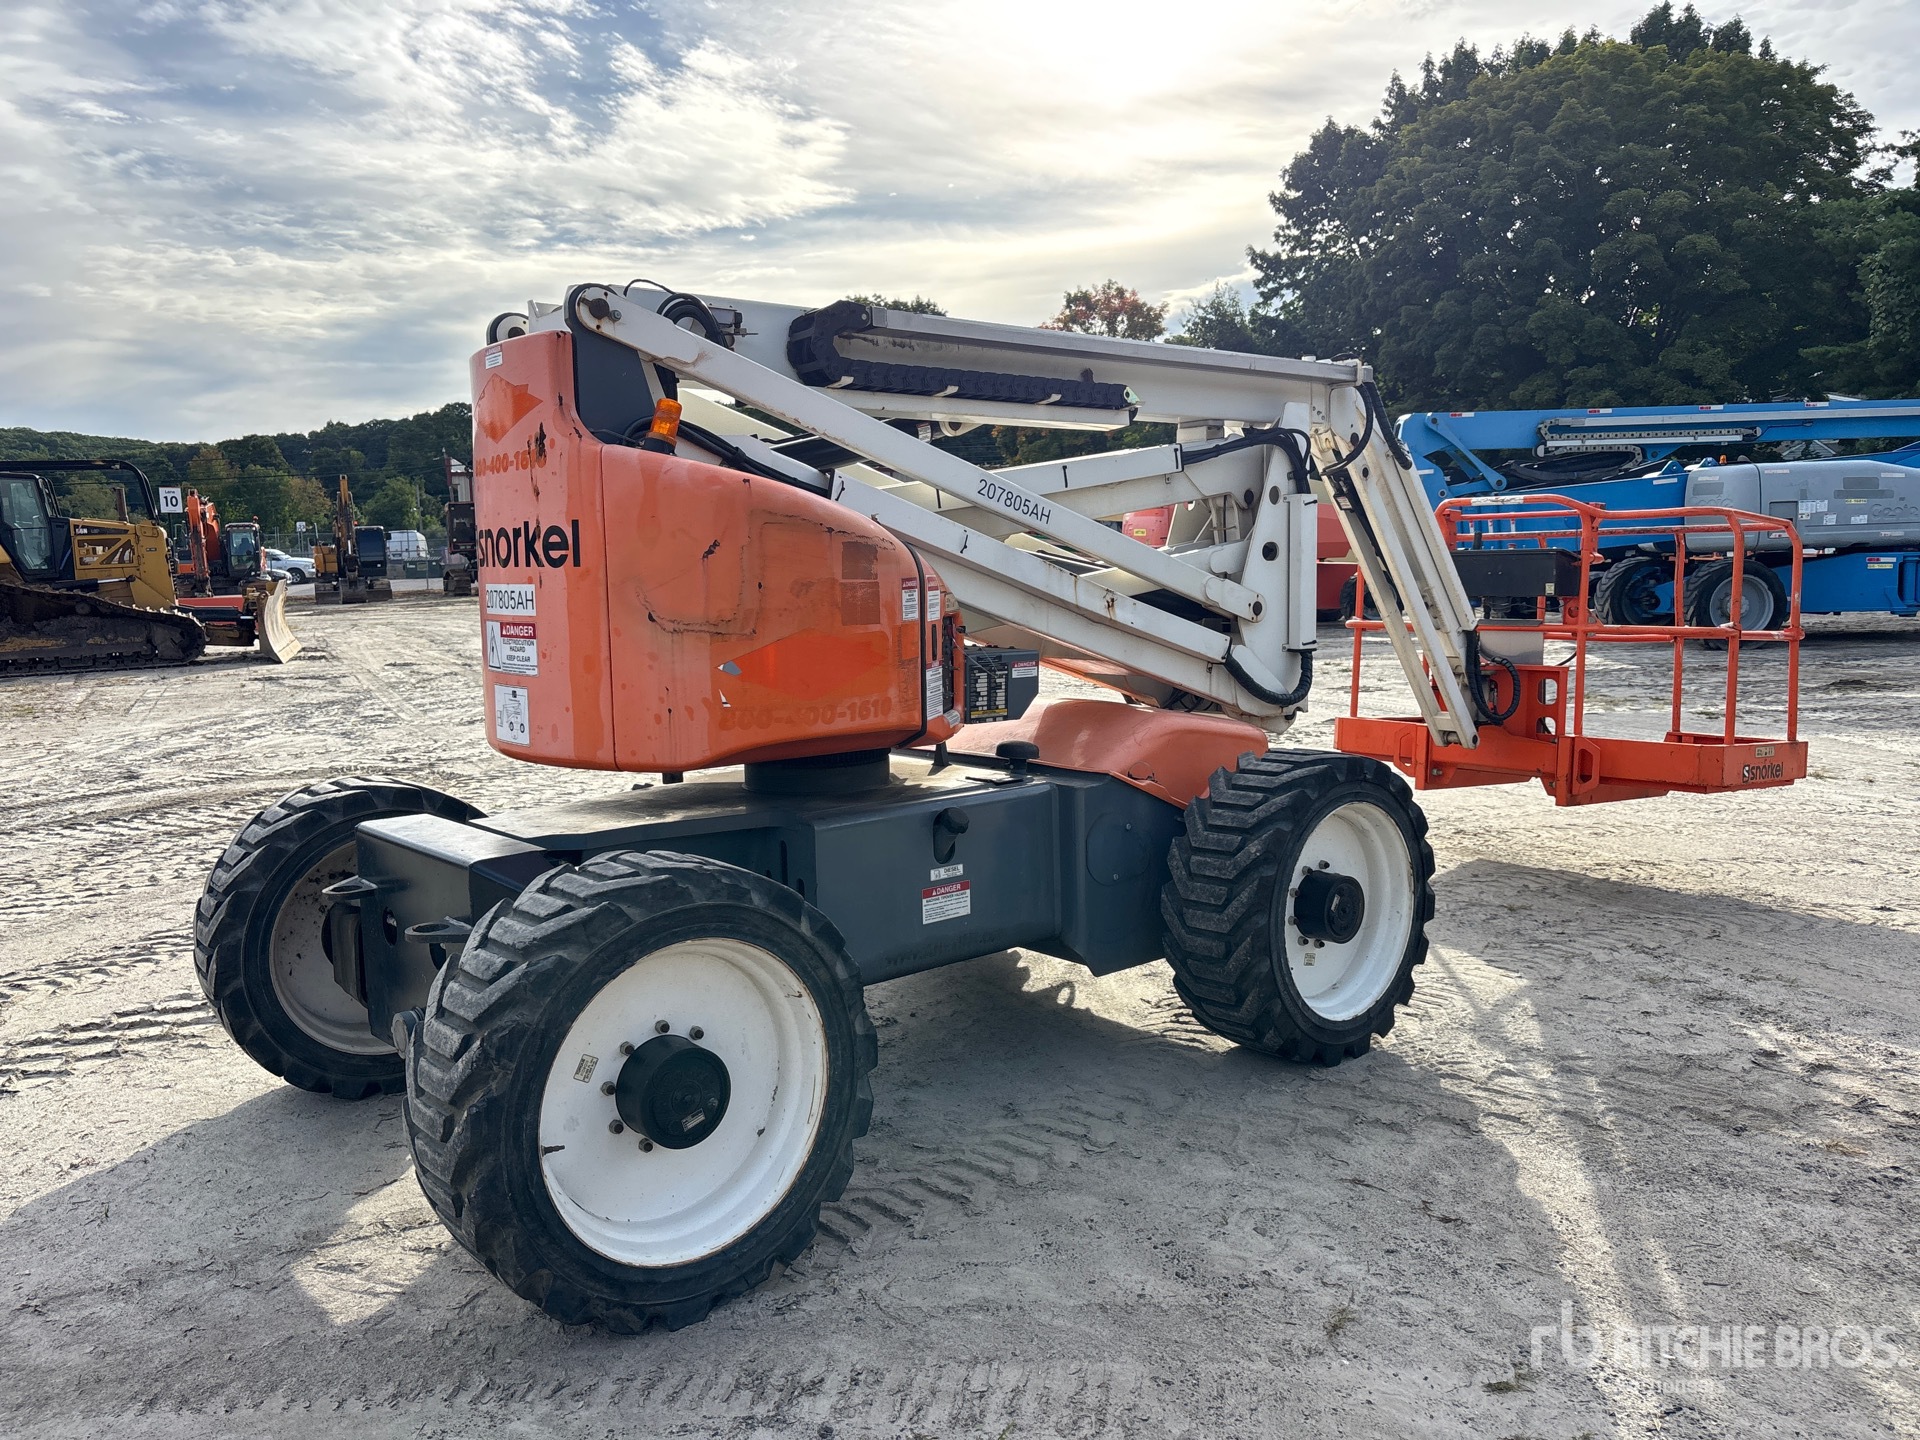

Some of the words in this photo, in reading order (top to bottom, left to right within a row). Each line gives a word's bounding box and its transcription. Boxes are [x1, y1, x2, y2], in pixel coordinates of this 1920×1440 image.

[163, 495, 179, 508] 10
[977, 478, 1052, 525] 207805AH
[478, 519, 581, 568] snorkel
[486, 589, 535, 611] 207805AH
[506, 624, 534, 637] DANGER
[502, 638, 535, 647] ELECTROCUTION
[506, 654, 516, 662] KEEP
[516, 655, 531, 663] CLEAR
[1750, 761, 1784, 780] snorkel
[937, 884, 961, 894] DANGER
